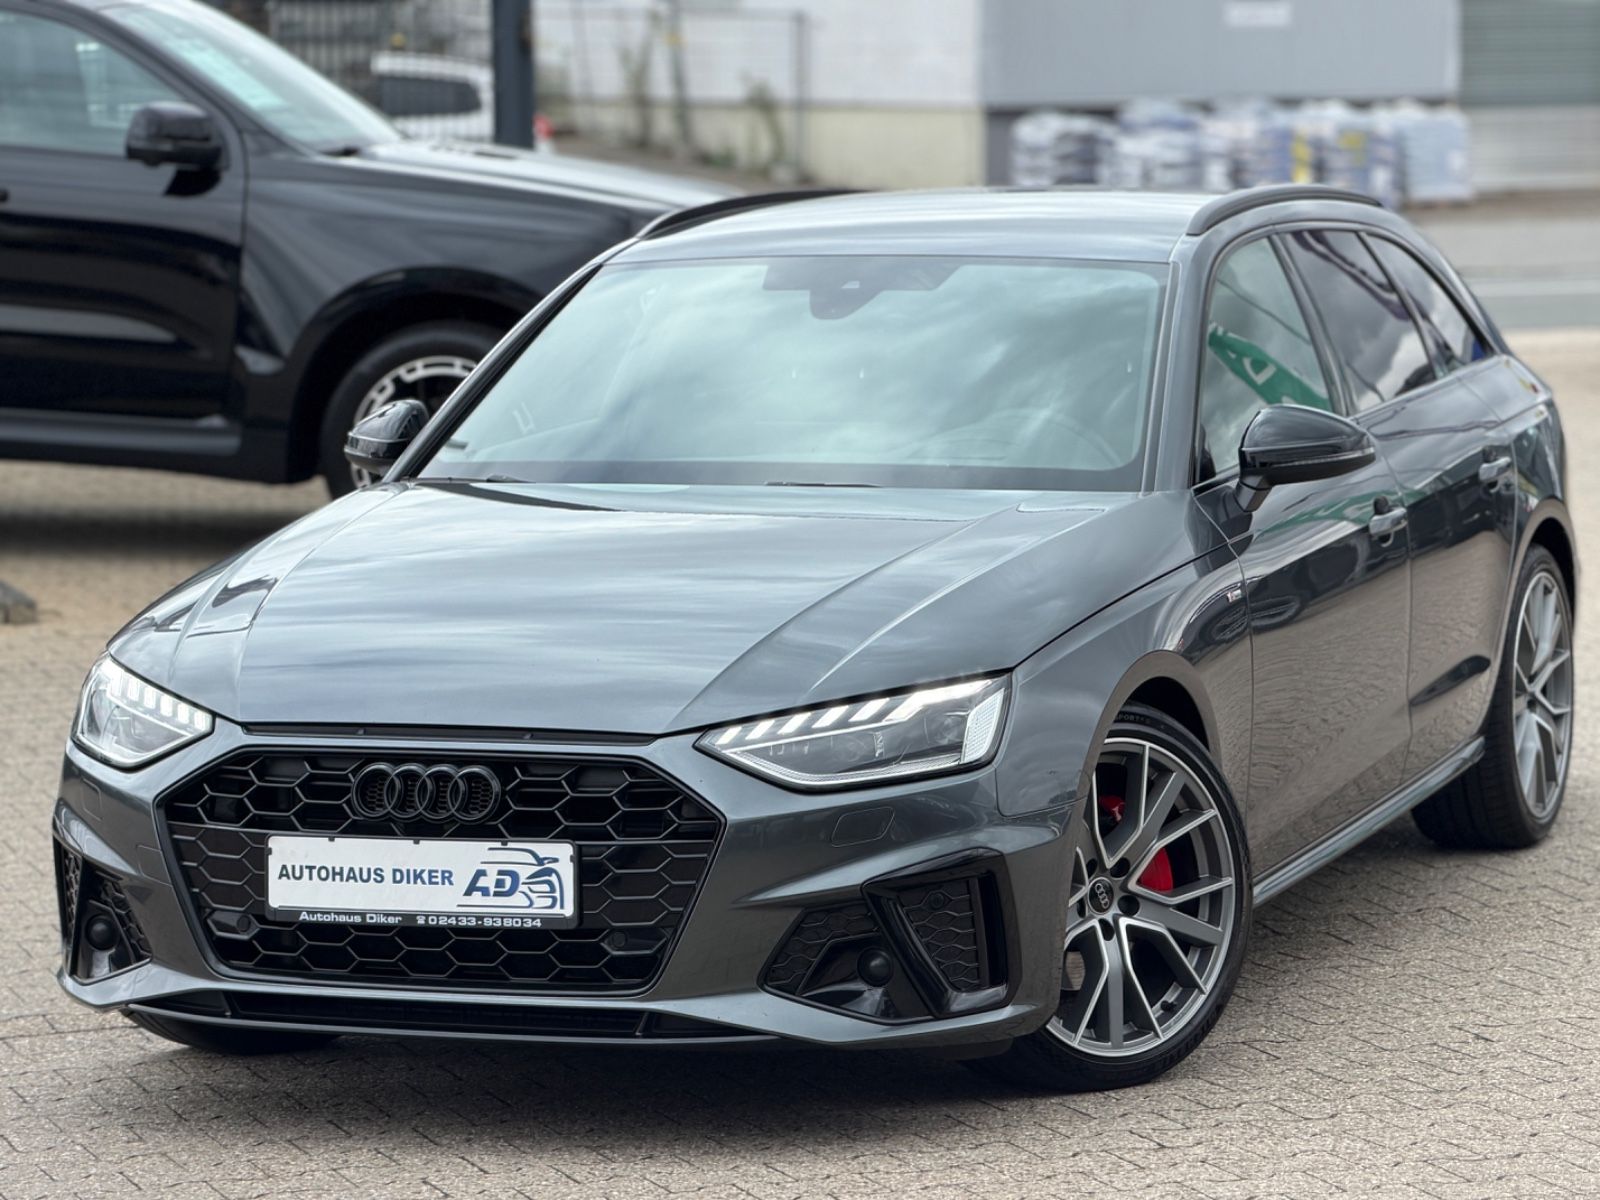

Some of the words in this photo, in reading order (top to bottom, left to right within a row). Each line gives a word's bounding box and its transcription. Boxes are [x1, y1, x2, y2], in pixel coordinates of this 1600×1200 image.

[278, 864, 384, 884] AUTOHAUS
[392, 868, 454, 886] DIKER
[463, 869, 520, 897] AD
[299, 911, 361, 922] Autohaus
[366, 914, 402, 924] Diker
[428, 915, 542, 927] 02433-938034
